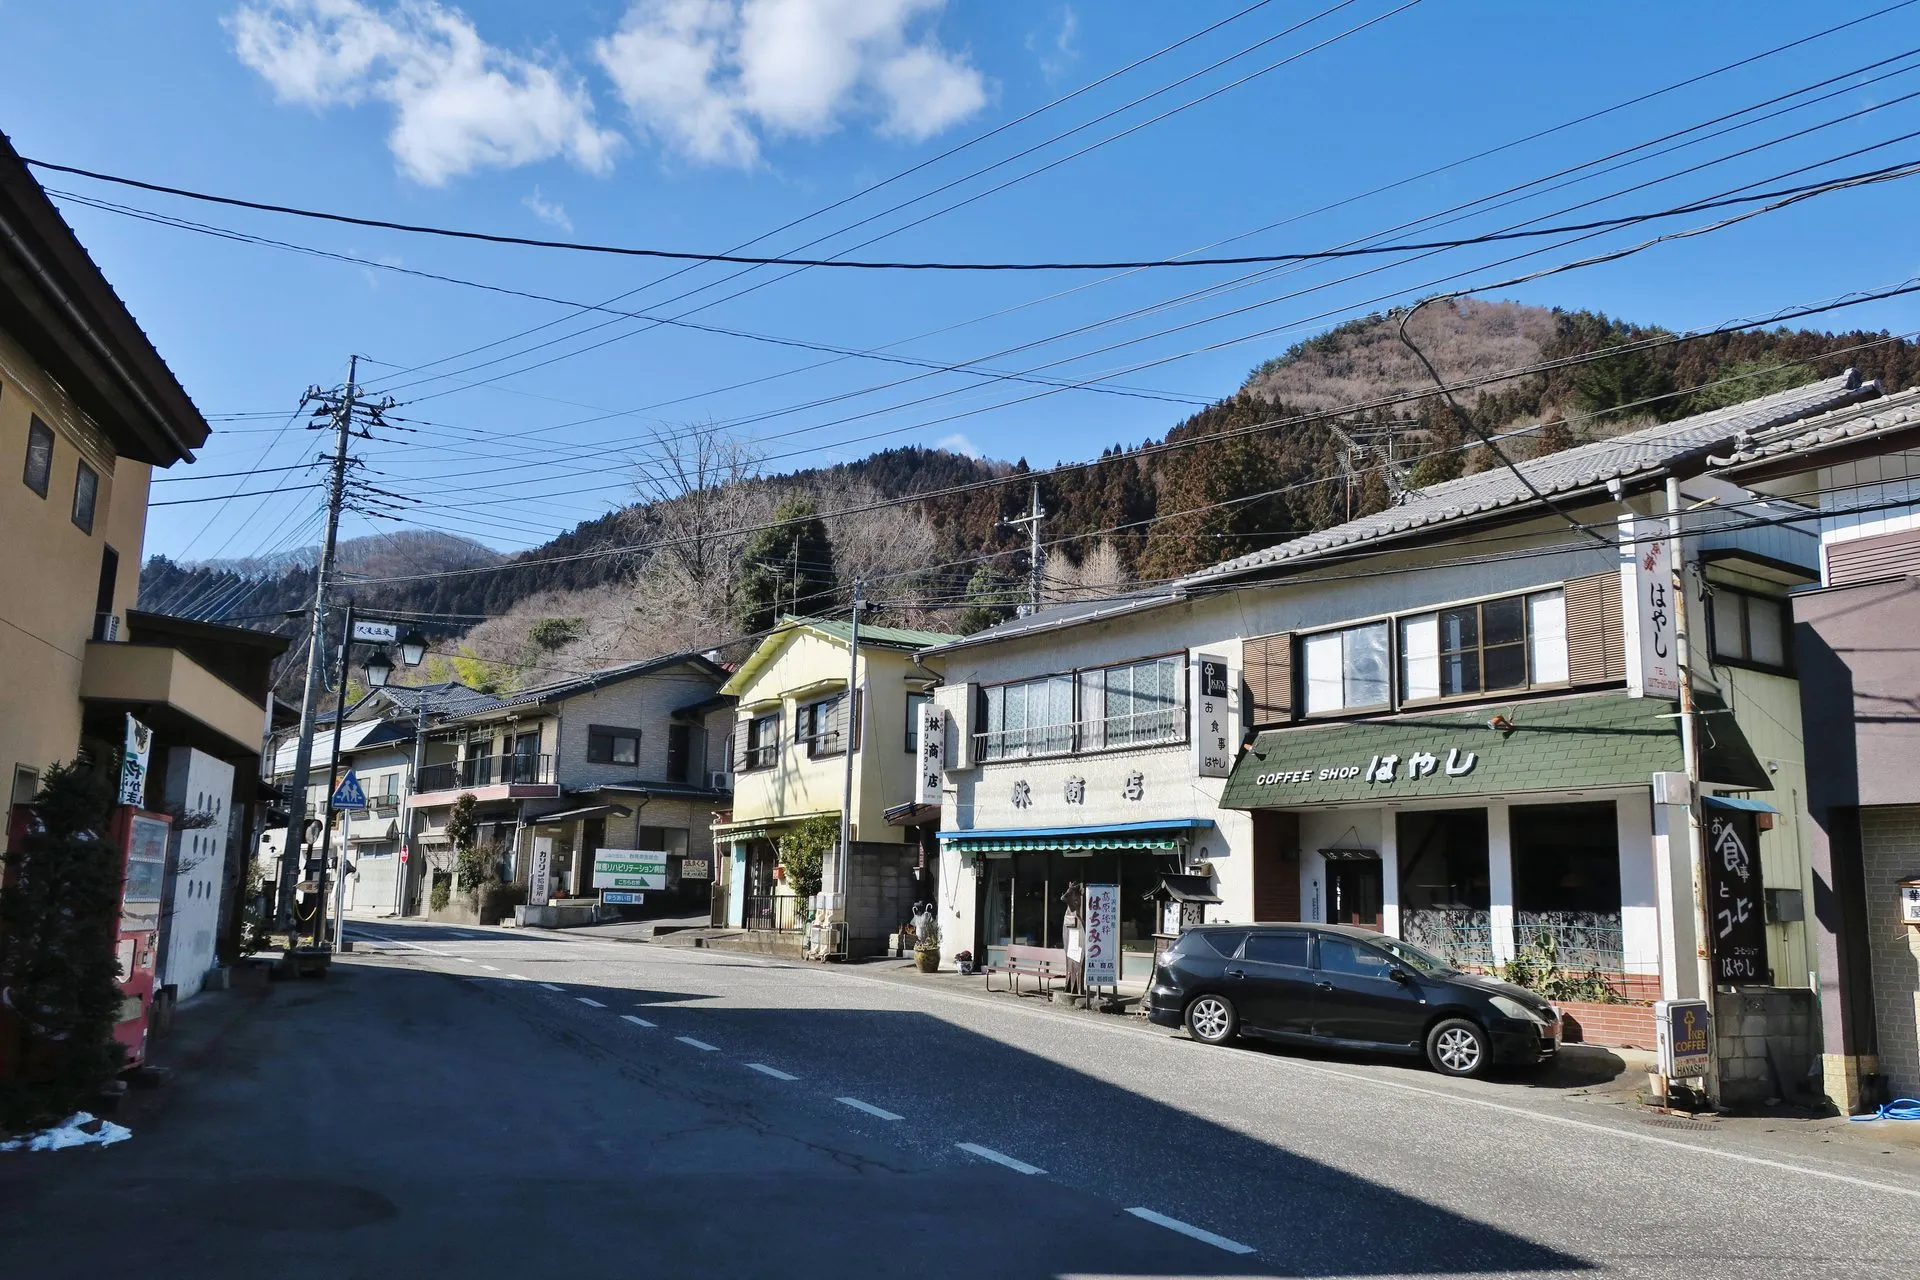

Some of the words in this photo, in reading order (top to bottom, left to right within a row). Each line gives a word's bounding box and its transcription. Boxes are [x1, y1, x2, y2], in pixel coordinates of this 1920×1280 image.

[1650, 582, 1667, 659] はやし
[356, 625, 394, 638] 沢渡温泉
[1654, 666, 1668, 677] TEL
[1211, 679, 1226, 687] KEY
[1204, 701, 1226, 751] お食事
[928, 716, 941, 789] 林商店
[1204, 756, 1226, 769] はやし
[1365, 748, 1477, 784] はやし
[1256, 769, 1314, 786] COFFEE
[1318, 766, 1361, 781] SHOP
[1011, 769, 1145, 809] 林商店
[1711, 817, 1750, 883] お食事
[1088, 896, 1102, 958] はちみつ
[1722, 958, 1755, 977] はやし
[1691, 1029, 1706, 1040] KEY
[1675, 1040, 1707, 1052] COFFEE
[1676, 1063, 1706, 1077] HAYASHI
